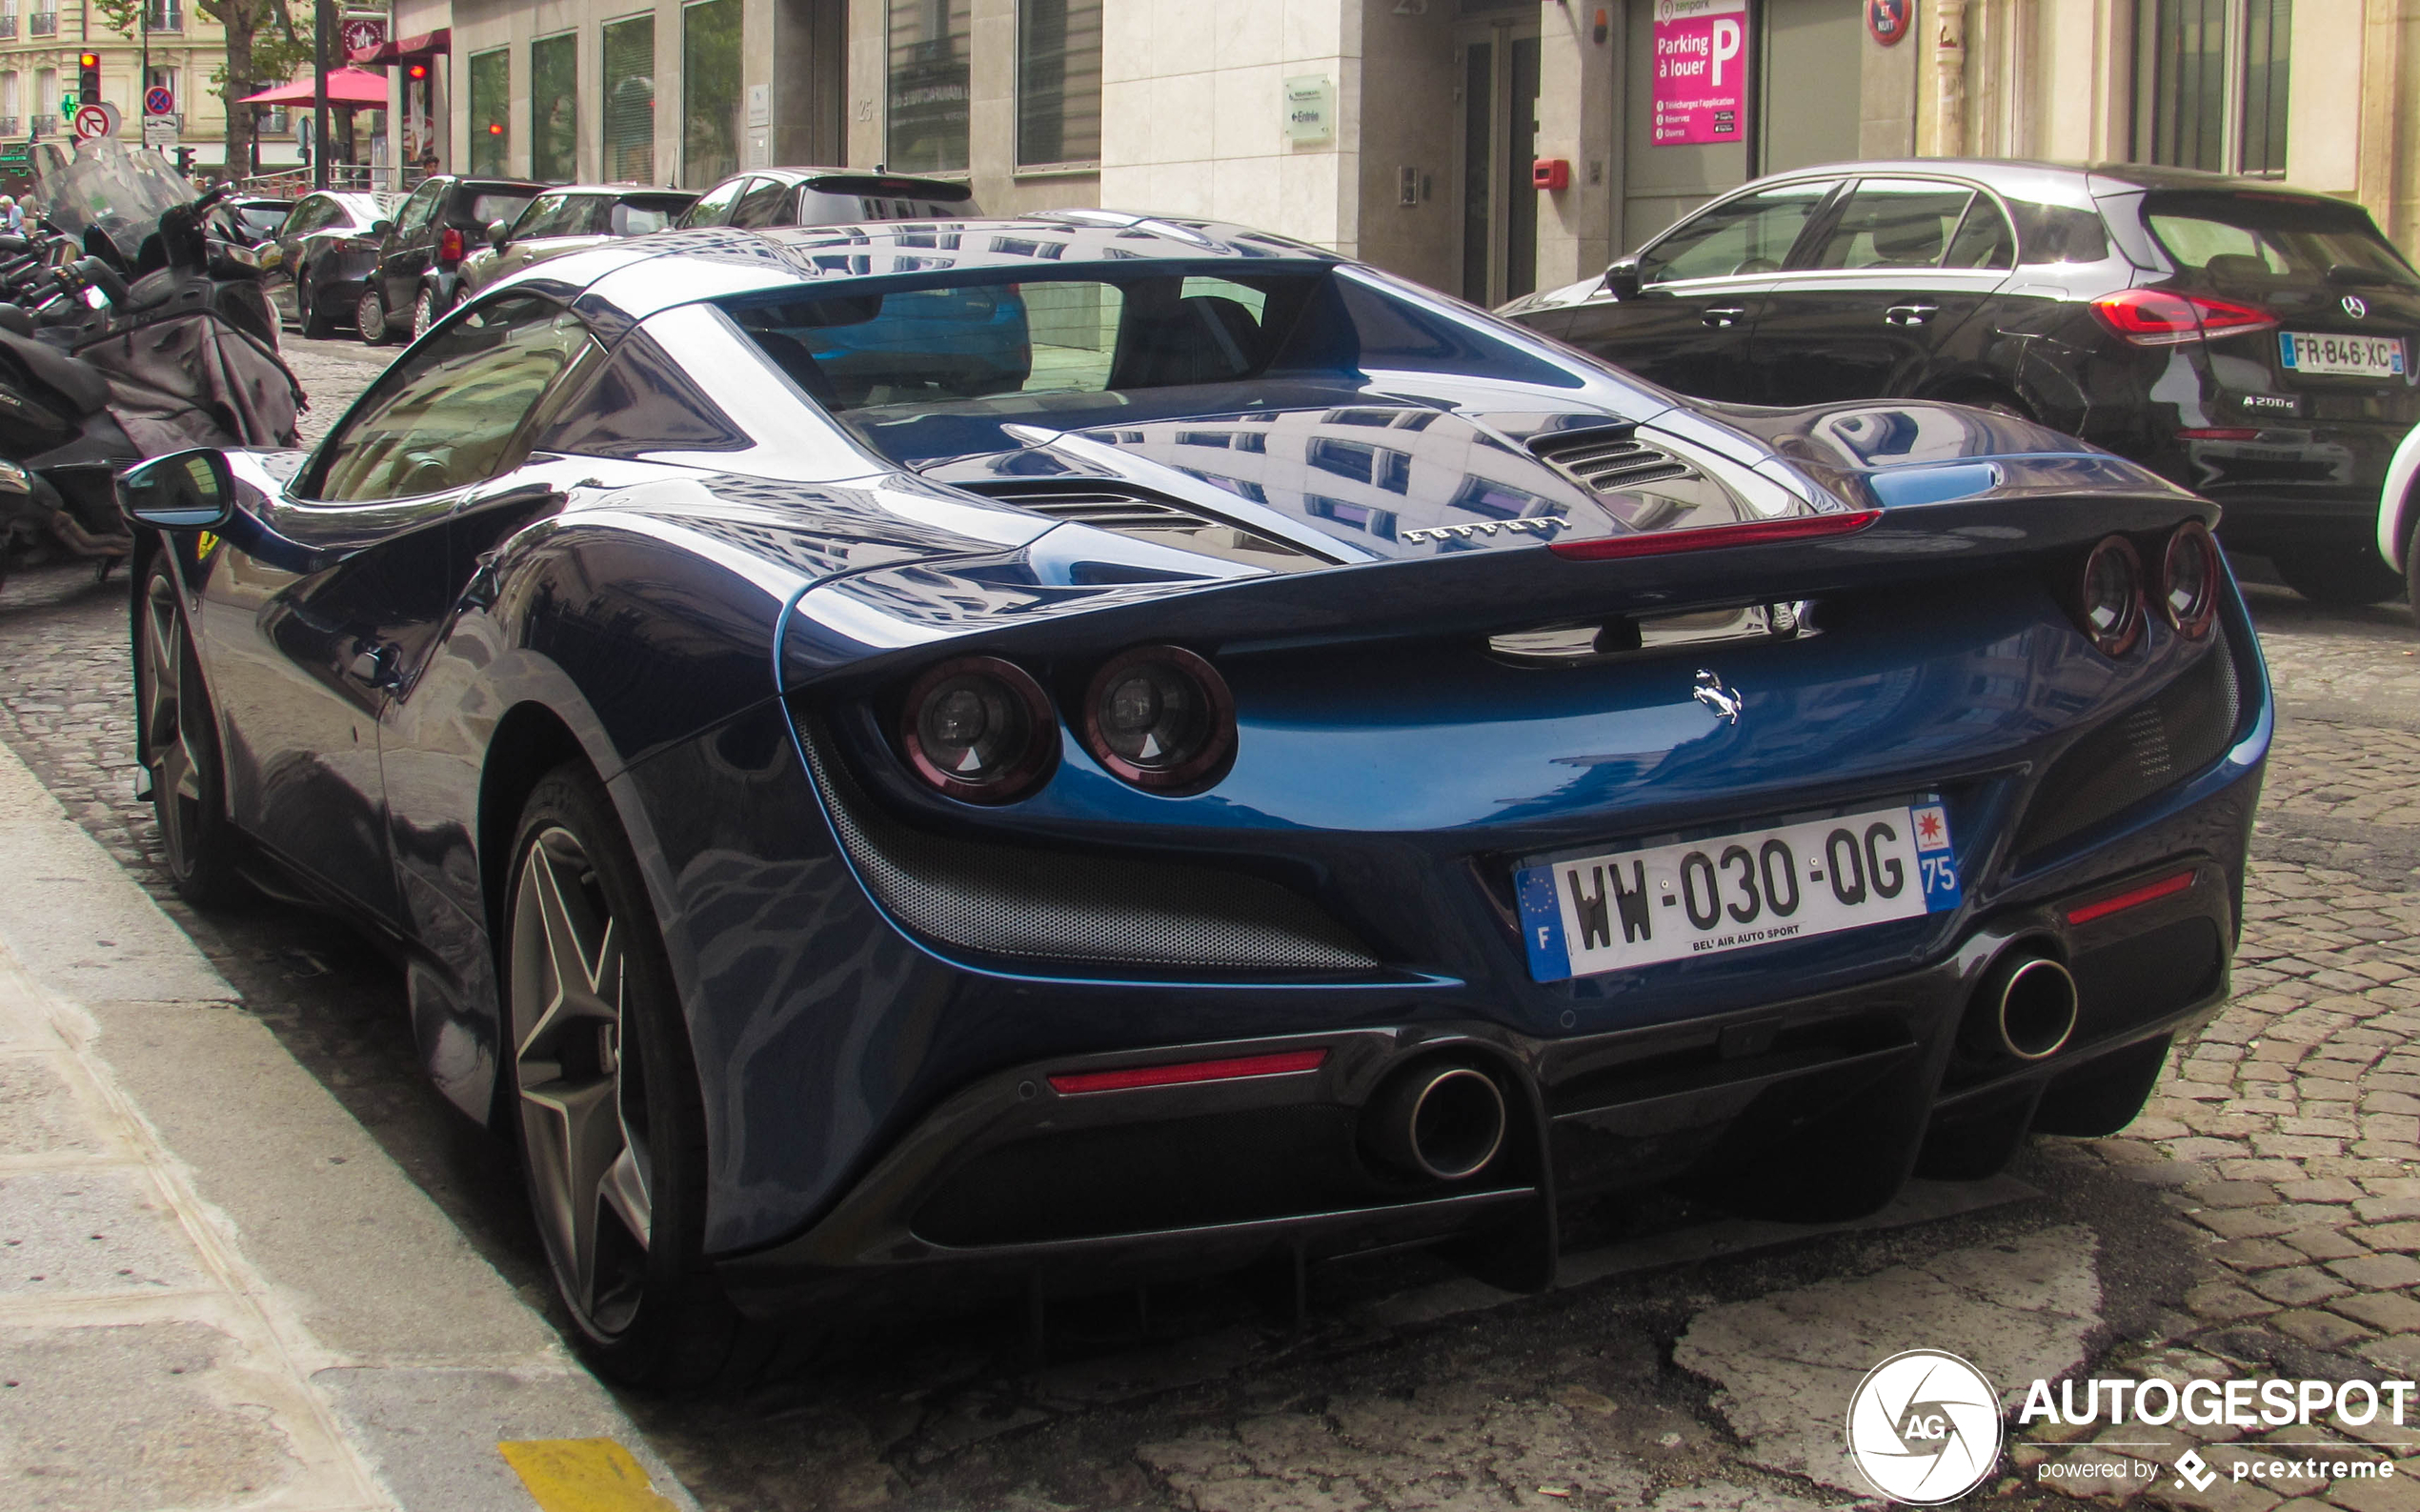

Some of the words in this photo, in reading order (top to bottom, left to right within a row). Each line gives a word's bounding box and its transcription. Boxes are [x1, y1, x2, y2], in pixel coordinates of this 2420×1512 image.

[1881, 5, 1890, 18] ET
[1877, 19, 1893, 31] NUIT
[1658, 34, 1709, 56] Parking
[1712, 19, 1741, 87] P
[1660, 59, 1667, 78] à
[1671, 59, 1705, 76] louer
[858, 97, 873, 122] 25
[1665, 99, 1699, 111] Téléchargez
[1700, 97, 1735, 109] l'application
[1665, 114, 1690, 123] Réservez
[1664, 129, 1684, 137] Ouvrez
[2294, 337, 2390, 367] FR-846-XC
[1537, 926, 1550, 950] F
[1567, 821, 1904, 951] WW-030-QG
[1921, 856, 1956, 894] 75
[1692, 938, 1715, 952] BEL'
[1717, 937, 1736, 948] AIR
[1737, 931, 1765, 945] AUTO
[1766, 925, 1800, 938] SPORT
